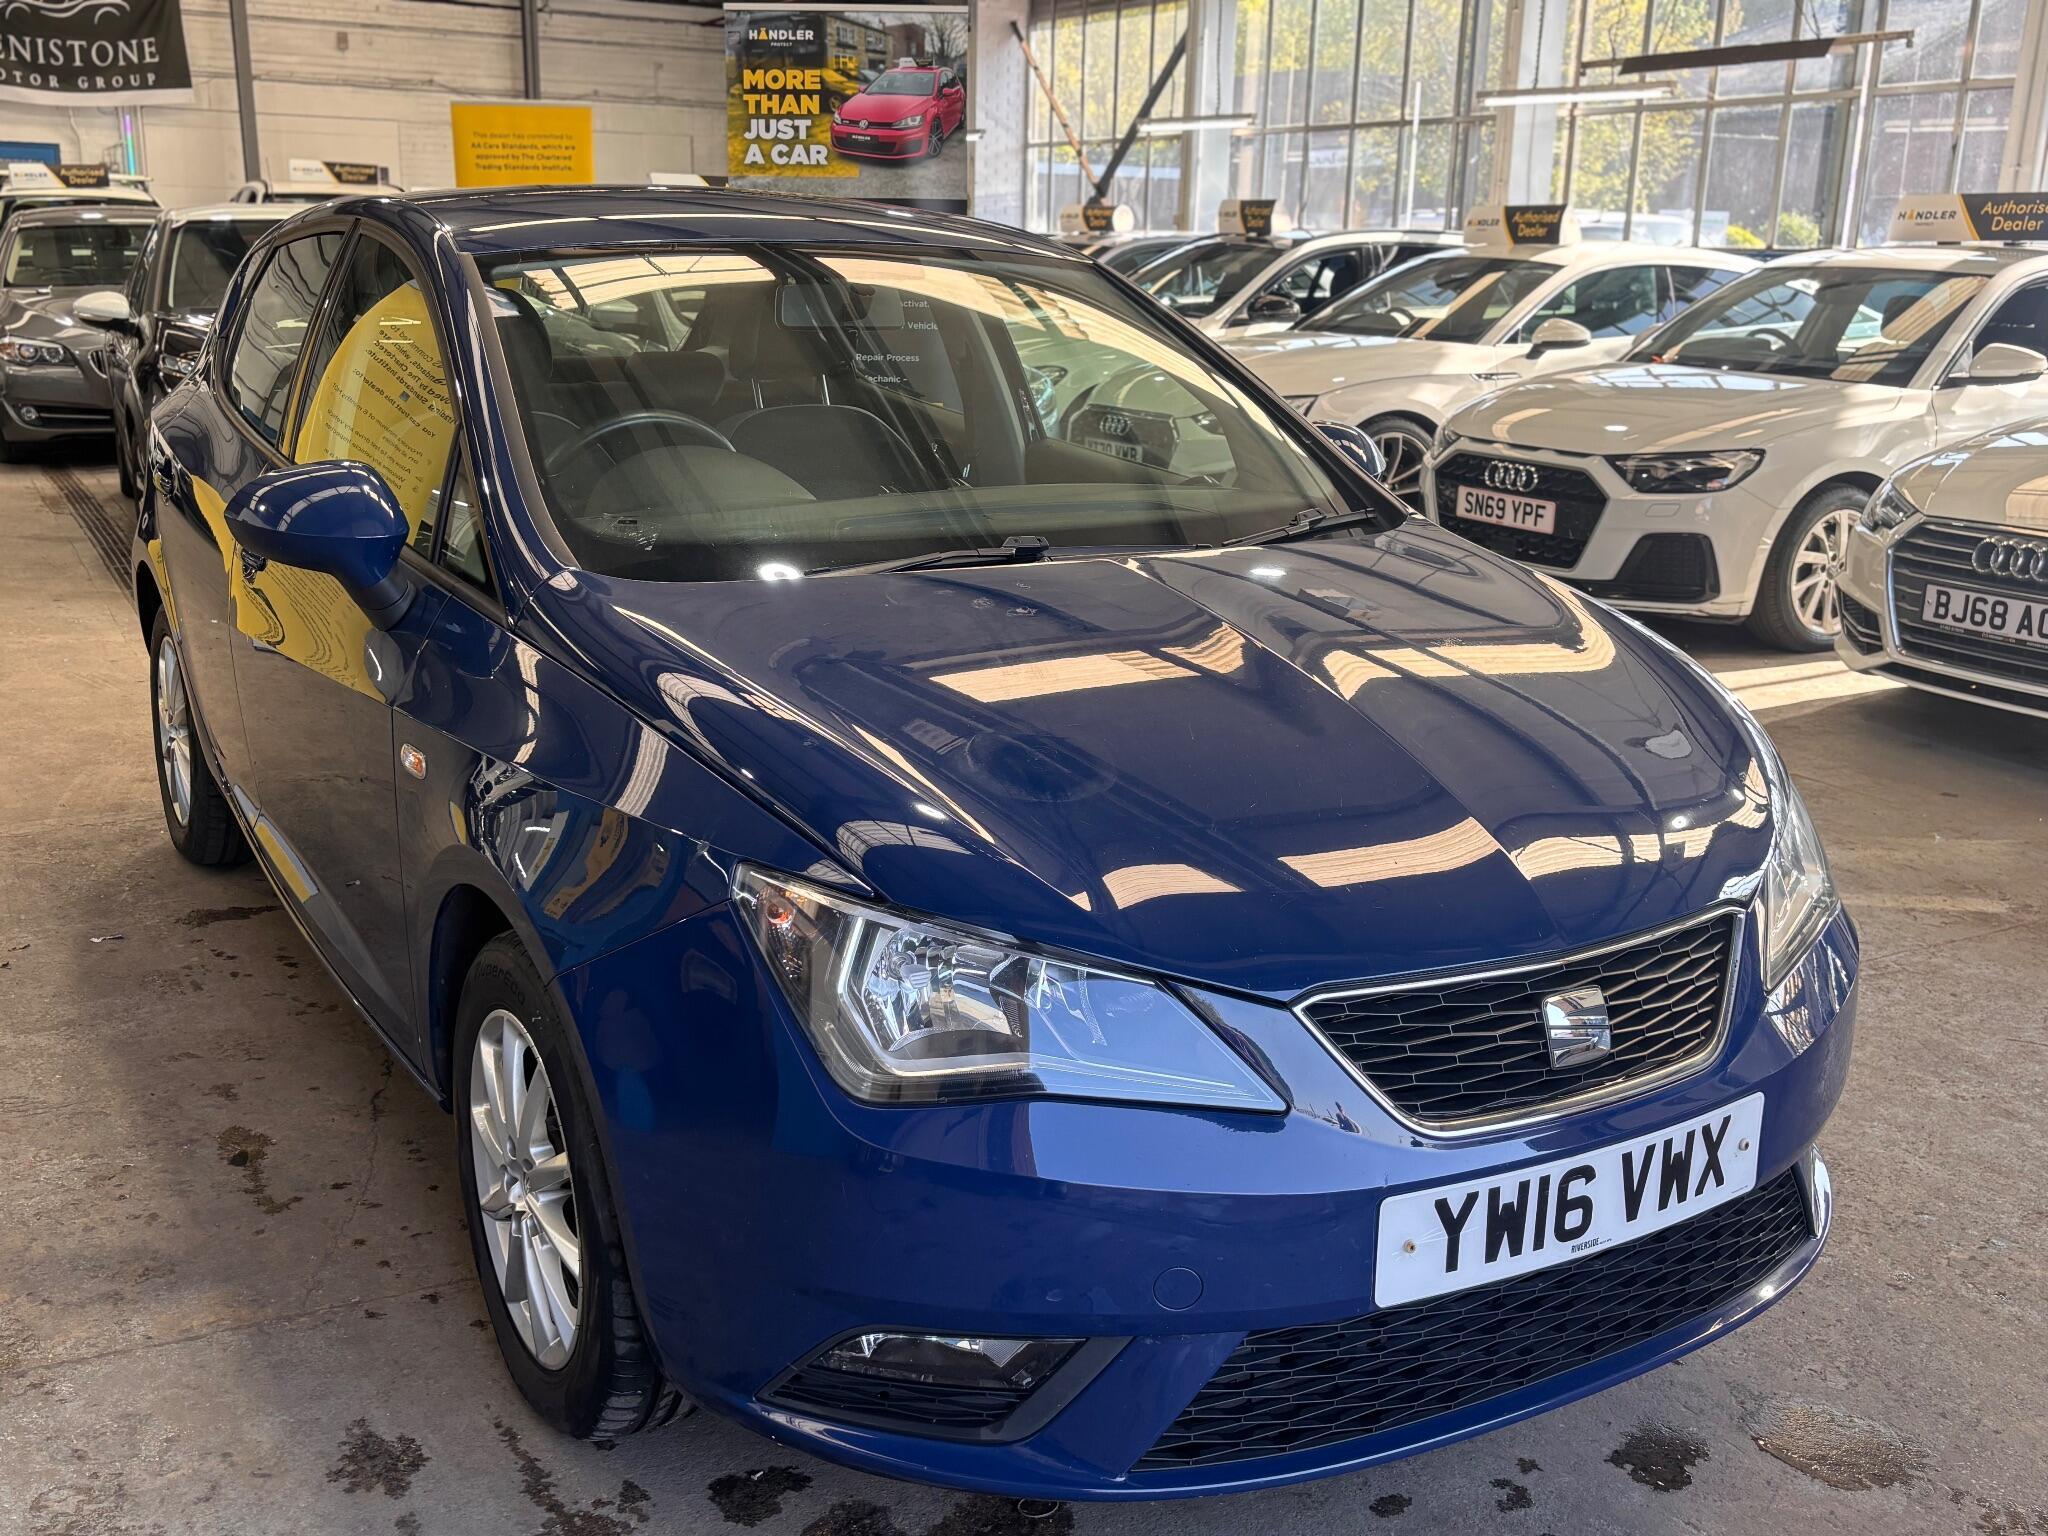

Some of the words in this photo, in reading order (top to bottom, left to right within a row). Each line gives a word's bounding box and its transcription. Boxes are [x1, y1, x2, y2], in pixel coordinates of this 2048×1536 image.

[78, 73, 156, 89] GROUP
[743, 69, 822, 90] MORE
[743, 94, 820, 115] THAN
[744, 119, 812, 140] JUST
[501, 142, 540, 150] Standards,
[744, 144, 765, 165] A
[771, 144, 828, 165] CAR
[475, 153, 510, 161] approved
[511, 153, 520, 161] by
[475, 163, 502, 171] Trading
[1517, 223, 1548, 237] Dealer
[1991, 216, 2044, 231] Dealer
[856, 353, 885, 363] Repair
[886, 354, 920, 362] Process
[1465, 491, 1506, 519] SN69
[1512, 500, 1546, 527] YPF
[1933, 589, 2008, 631] BJ68
[1434, 1164, 1597, 1273] YW16
[1621, 1114, 1732, 1223] VWX
[1571, 1236, 1600, 1253] RIVERSIDE
